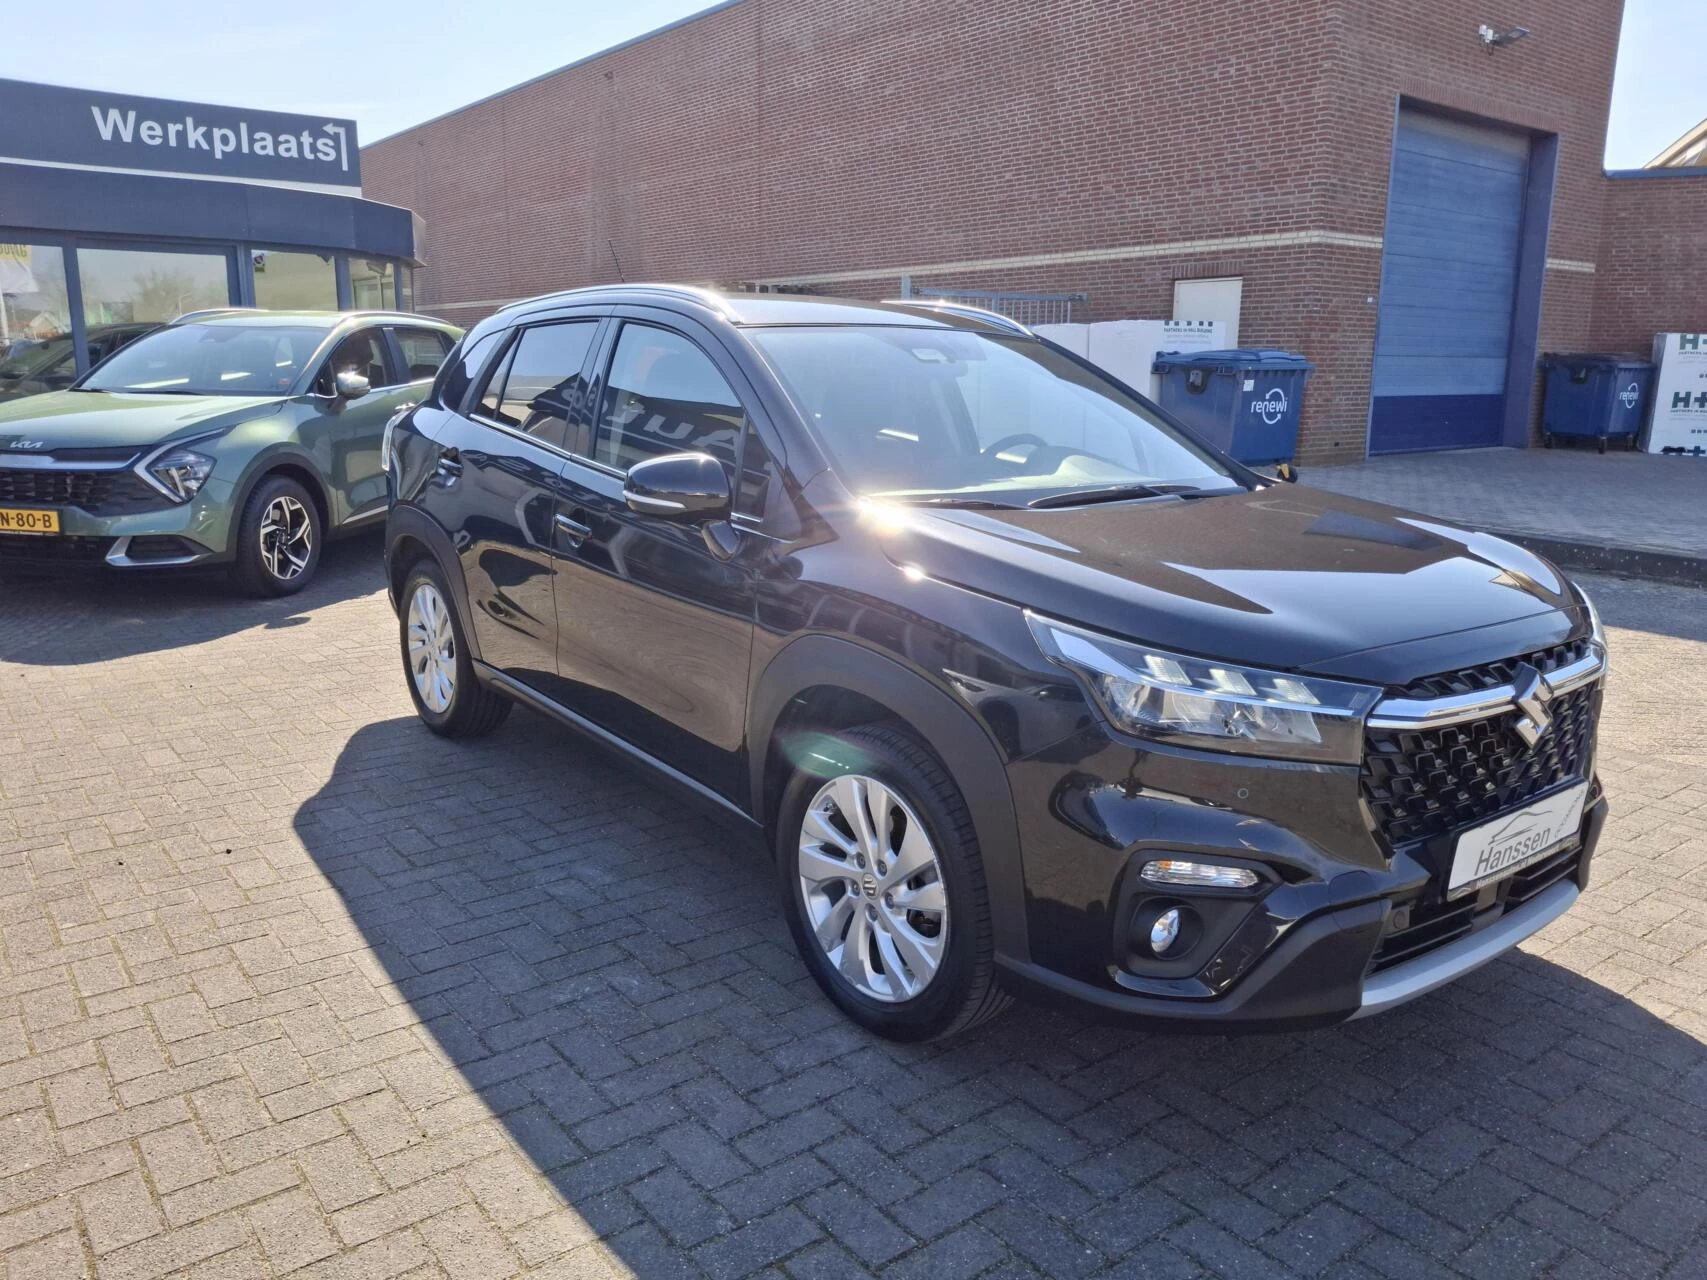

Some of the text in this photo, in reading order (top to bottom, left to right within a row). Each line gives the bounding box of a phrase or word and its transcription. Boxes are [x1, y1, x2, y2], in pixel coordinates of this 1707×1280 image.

[91, 106, 337, 162] Werkplaats
[1250, 397, 1288, 413] renewi
[1474, 828, 1551, 876] Hanssen
